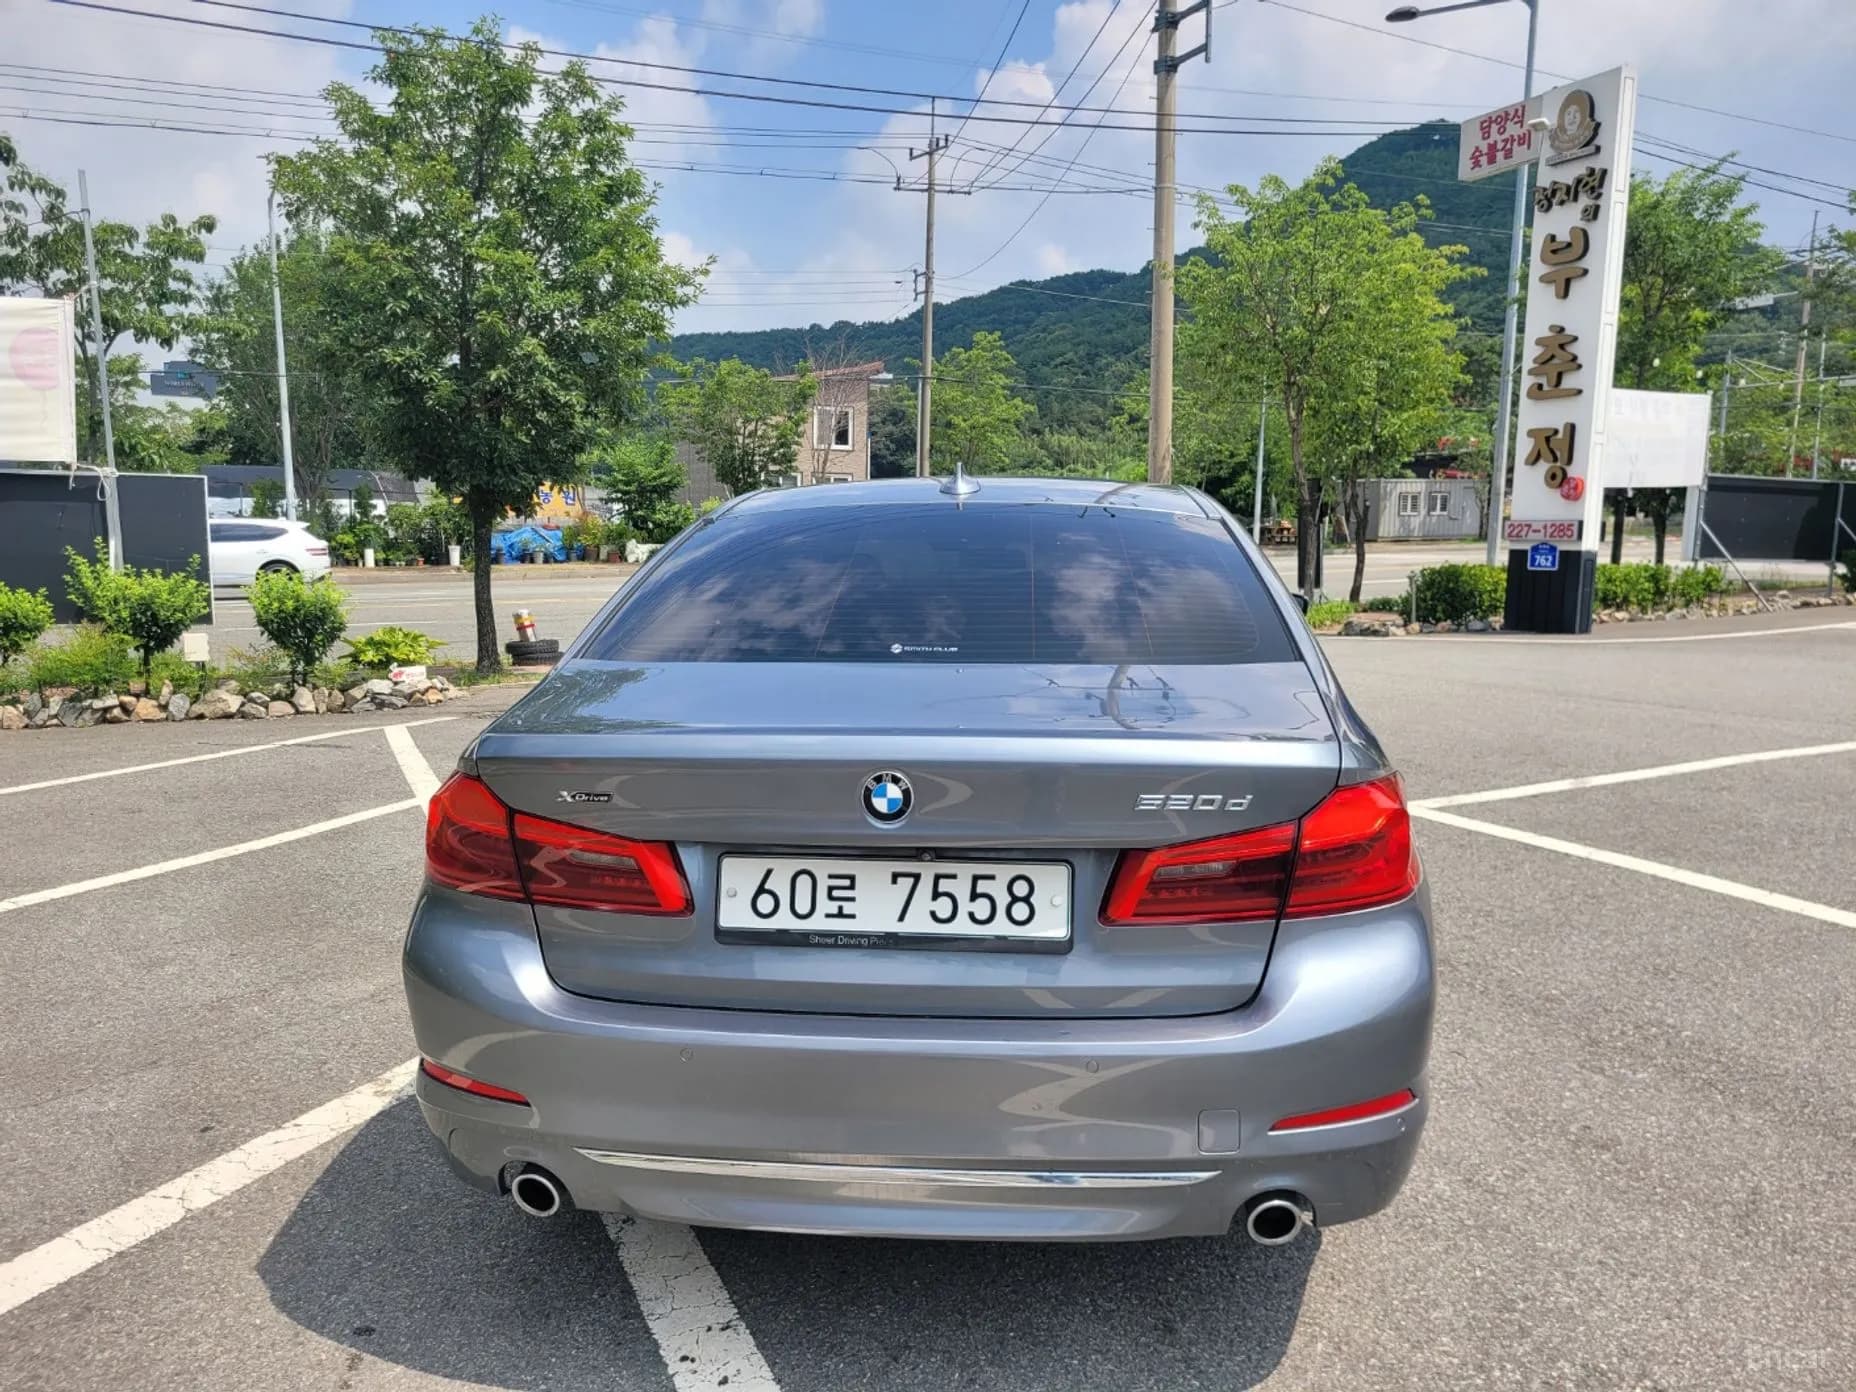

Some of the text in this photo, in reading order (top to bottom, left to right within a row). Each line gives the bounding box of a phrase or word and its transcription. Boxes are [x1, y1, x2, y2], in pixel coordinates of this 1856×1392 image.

[1479, 104, 1526, 140] 담양식
[1469, 129, 1531, 170] 숯불갈비
[1524, 226, 1589, 489] 부춘정
[1506, 522, 1575, 541] 227-1285
[1534, 555, 1553, 566] 762
[750, 867, 1037, 927] 60로 7558
